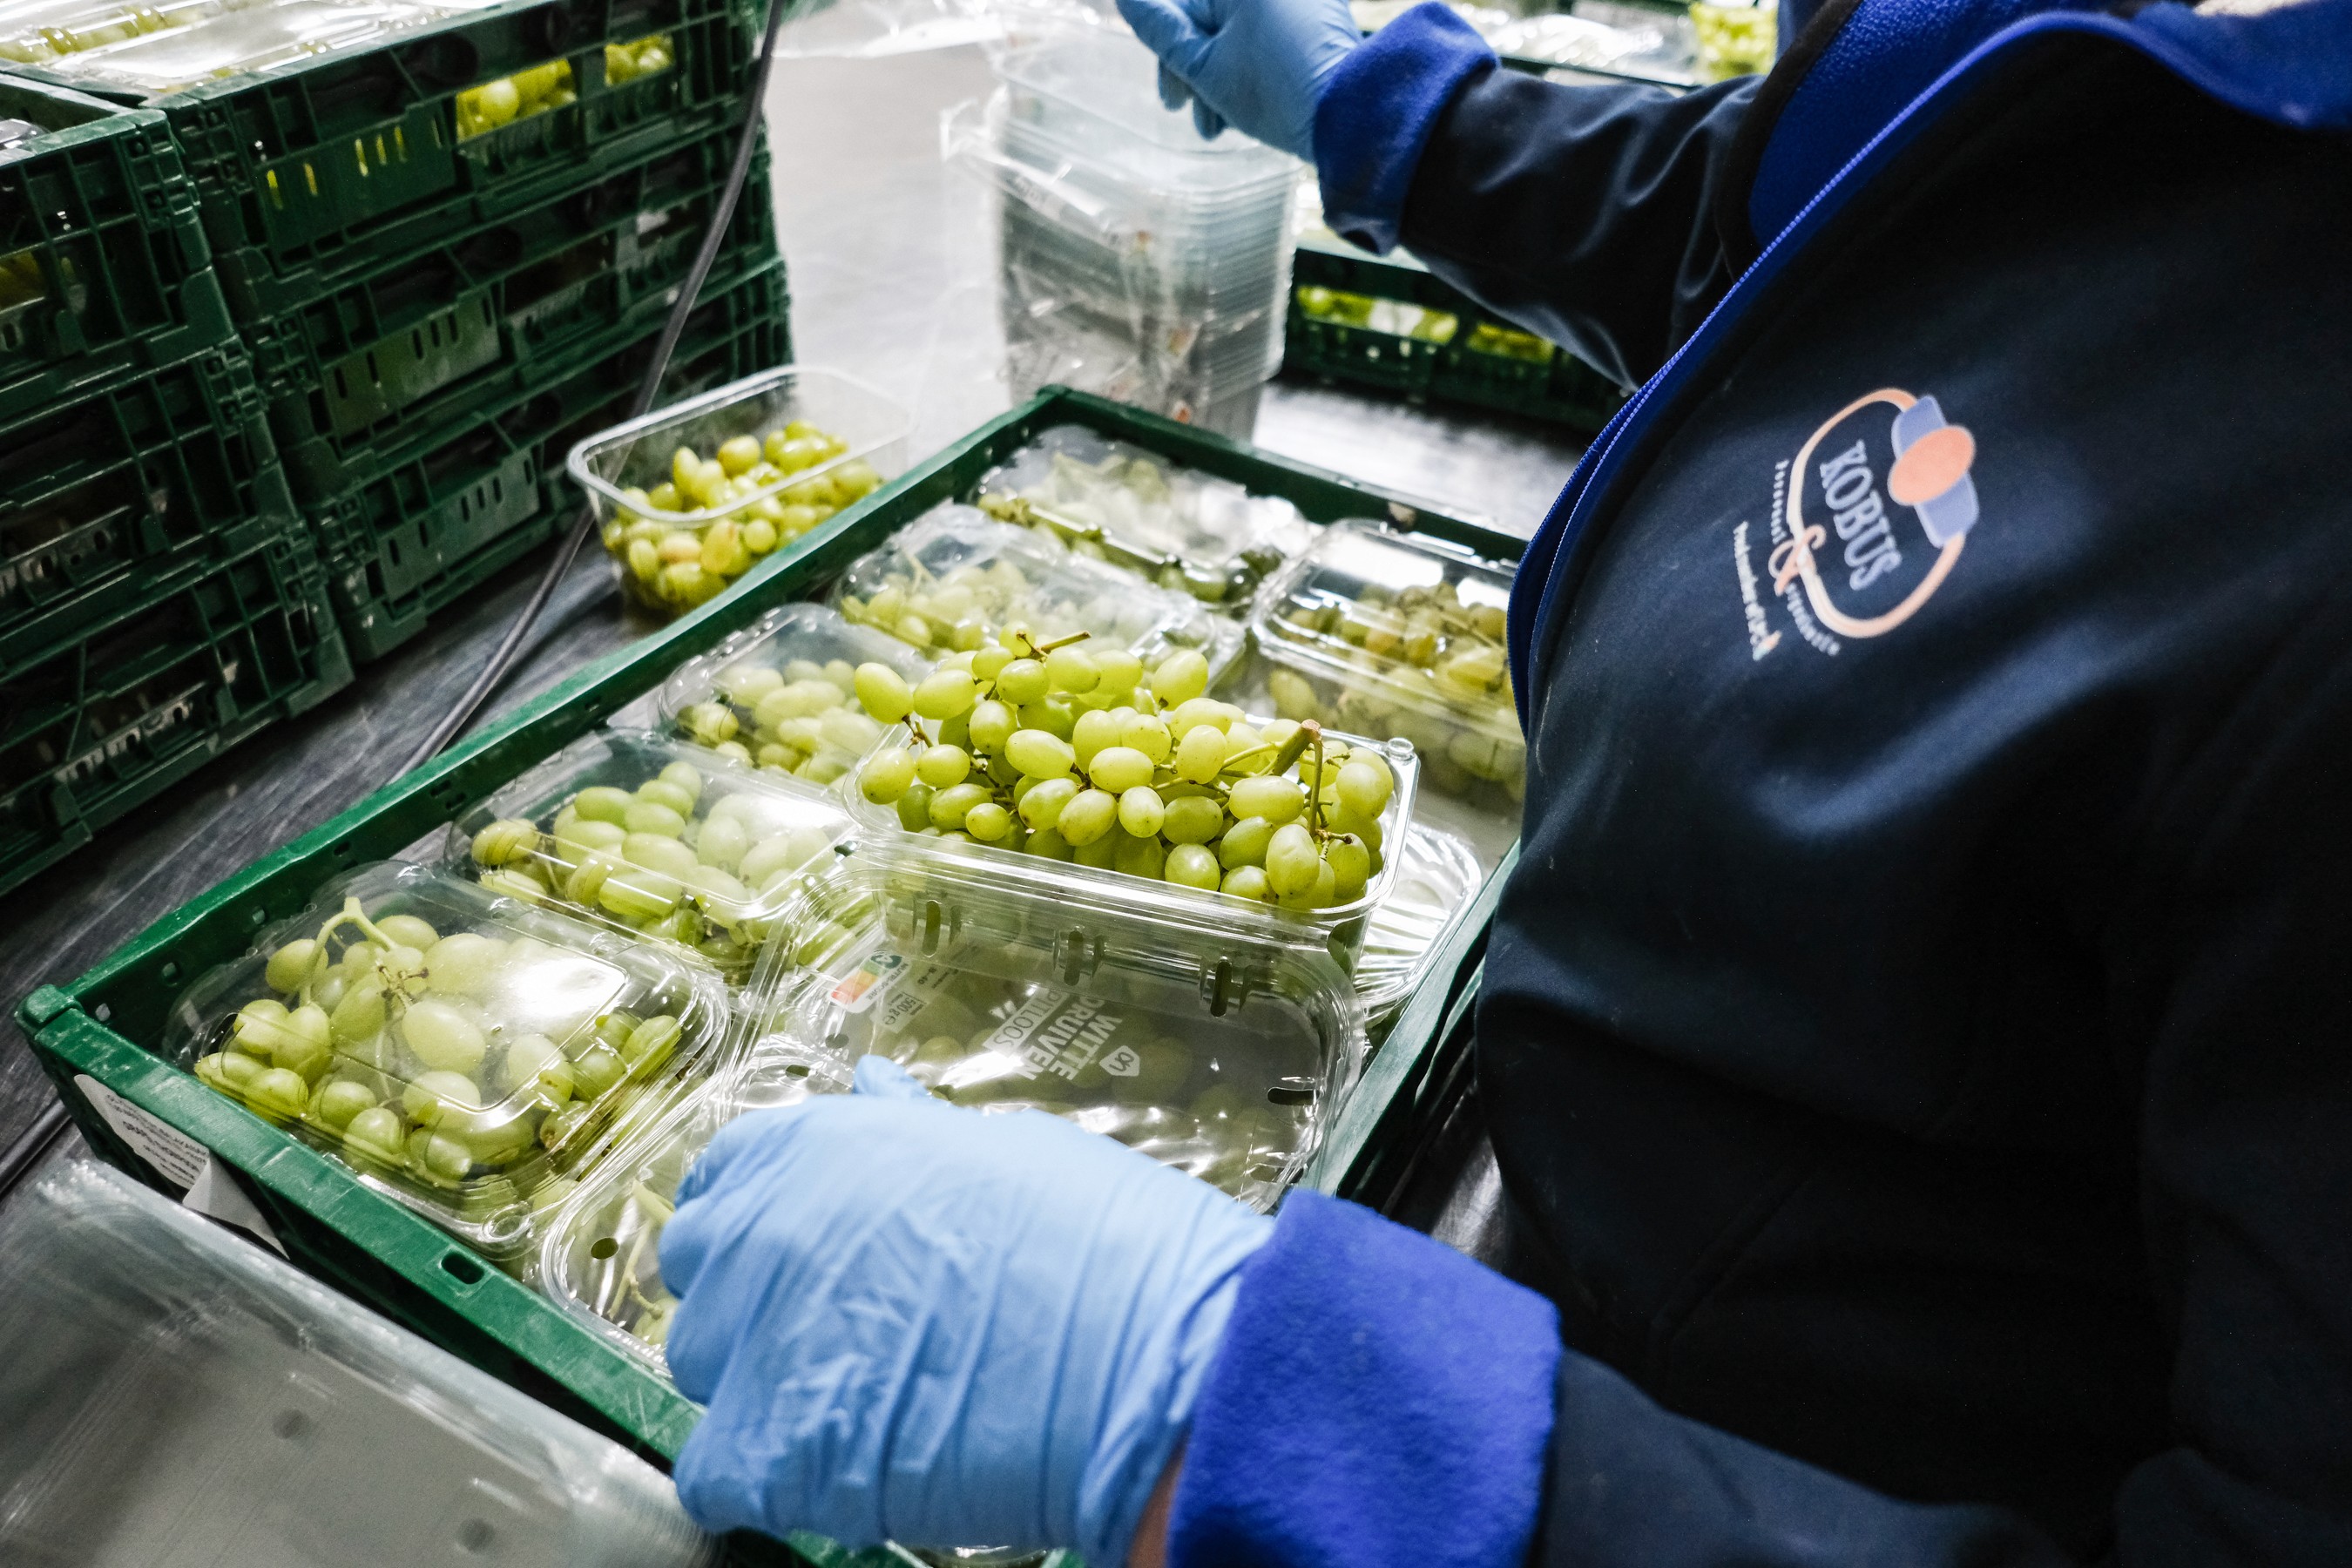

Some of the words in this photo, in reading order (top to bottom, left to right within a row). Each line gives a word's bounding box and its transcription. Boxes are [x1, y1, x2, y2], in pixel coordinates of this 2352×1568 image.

[1820, 439, 1903, 591] KOBUS
[865, 962, 909, 1000] NUTRI-SCORE
[897, 997, 916, 1012] 500
[993, 989, 1062, 1046] PITLOOS
[1012, 996, 1105, 1081] DRUIVEN
[1048, 1014, 1123, 1081] WITTE
